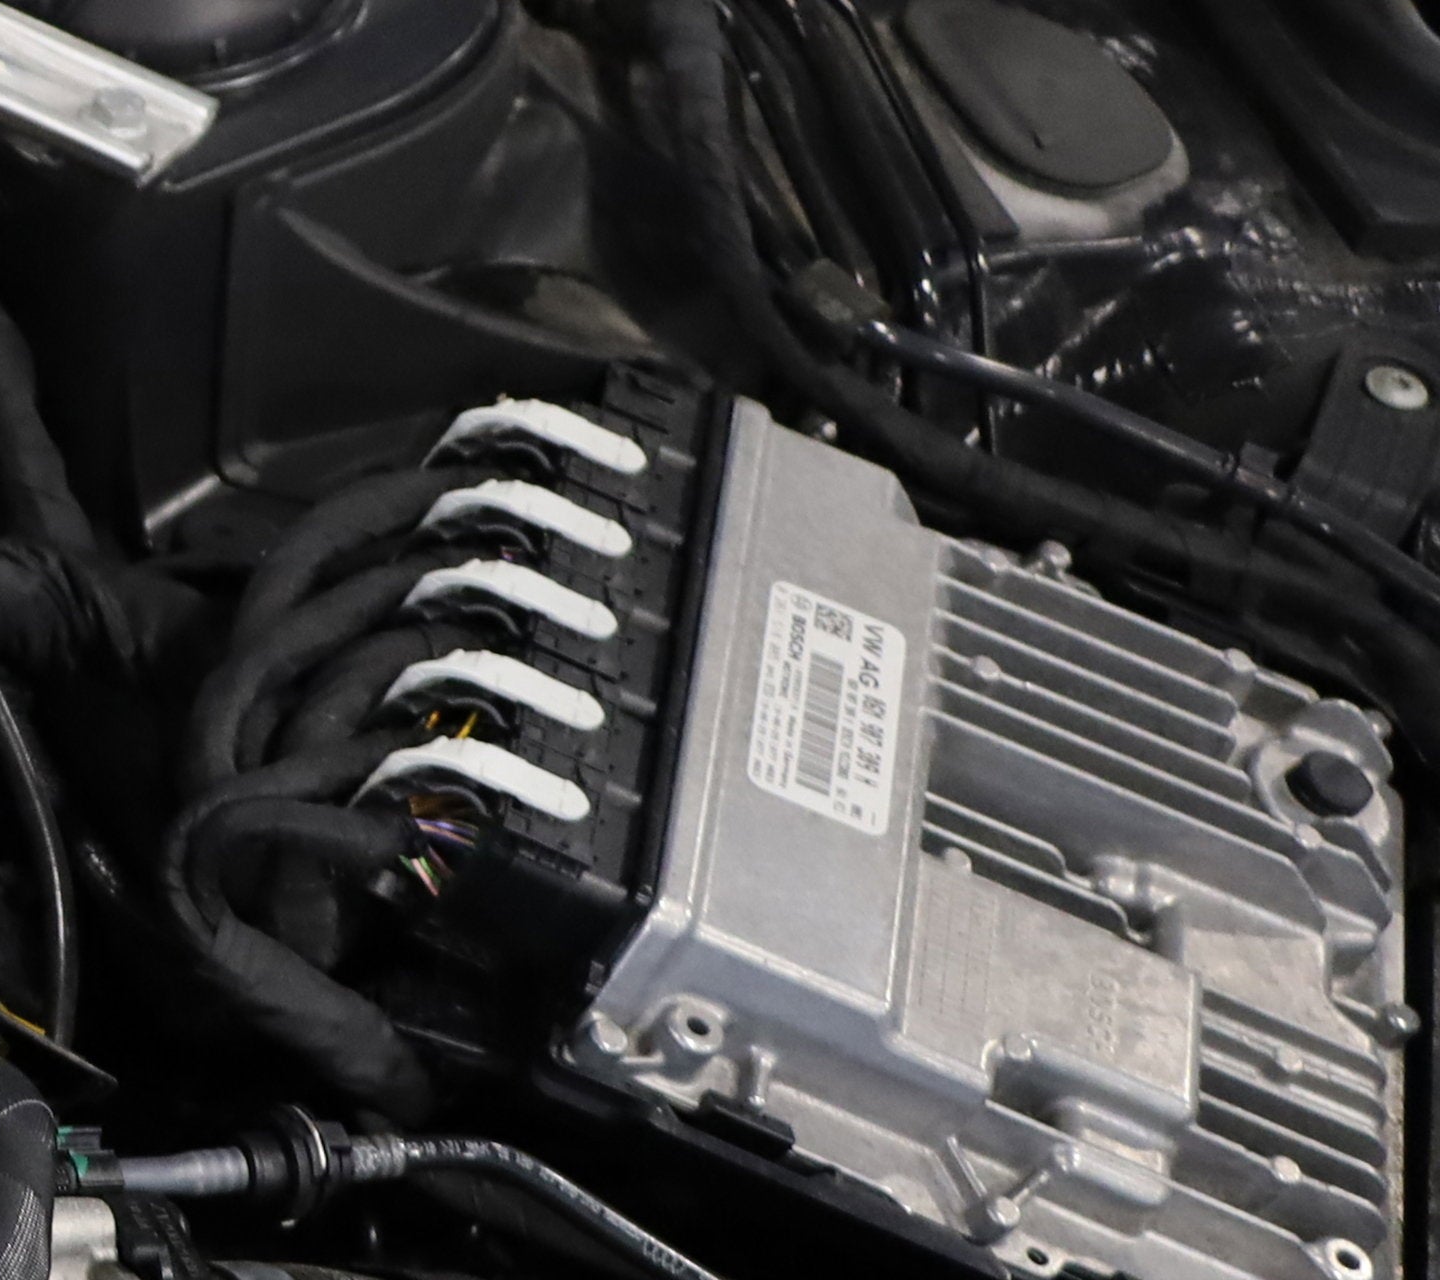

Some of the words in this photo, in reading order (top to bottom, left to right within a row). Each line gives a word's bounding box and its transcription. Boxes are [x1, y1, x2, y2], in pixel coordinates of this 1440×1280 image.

[787, 613, 807, 661] BOSCH
[862, 623, 884, 657] VW
[858, 656, 880, 689] AG
